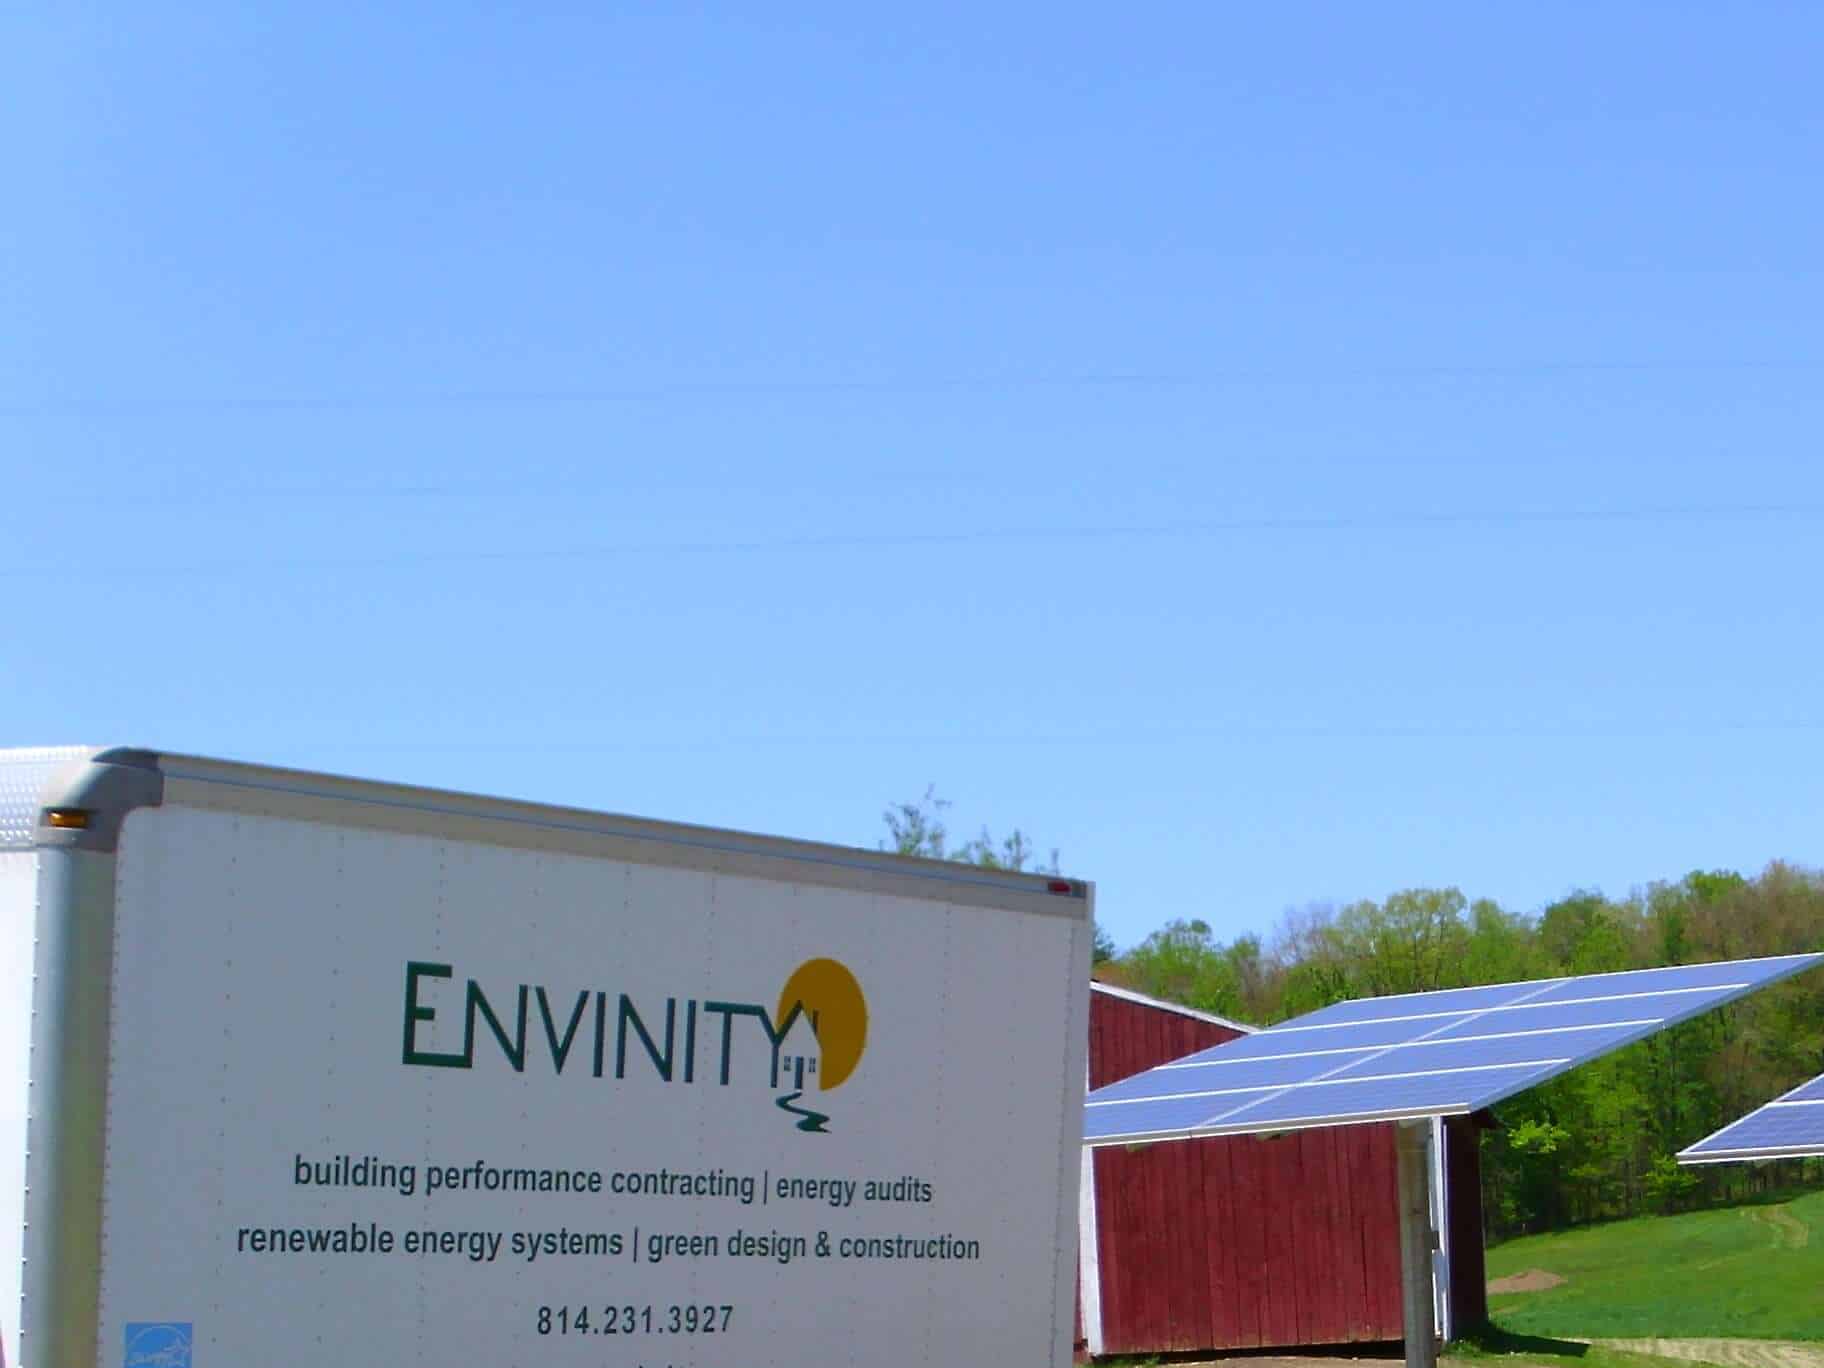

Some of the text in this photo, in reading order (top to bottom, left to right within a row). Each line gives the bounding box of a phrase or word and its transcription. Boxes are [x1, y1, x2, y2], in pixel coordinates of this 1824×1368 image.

[402, 960, 807, 1089] ENVINITY
[294, 1154, 417, 1196] building
[425, 1160, 602, 1198] performance
[610, 1168, 756, 1204] contracting
[776, 1178, 857, 1208] energy
[864, 1176, 933, 1203] audits
[237, 1222, 395, 1254] renewable
[404, 1231, 503, 1263] energy
[511, 1227, 624, 1263] systems
[647, 1234, 719, 1264] green
[727, 1228, 807, 1265] design
[814, 1231, 832, 1259] &
[839, 1233, 980, 1260] construction
[536, 1305, 734, 1336] 814.231.3927
